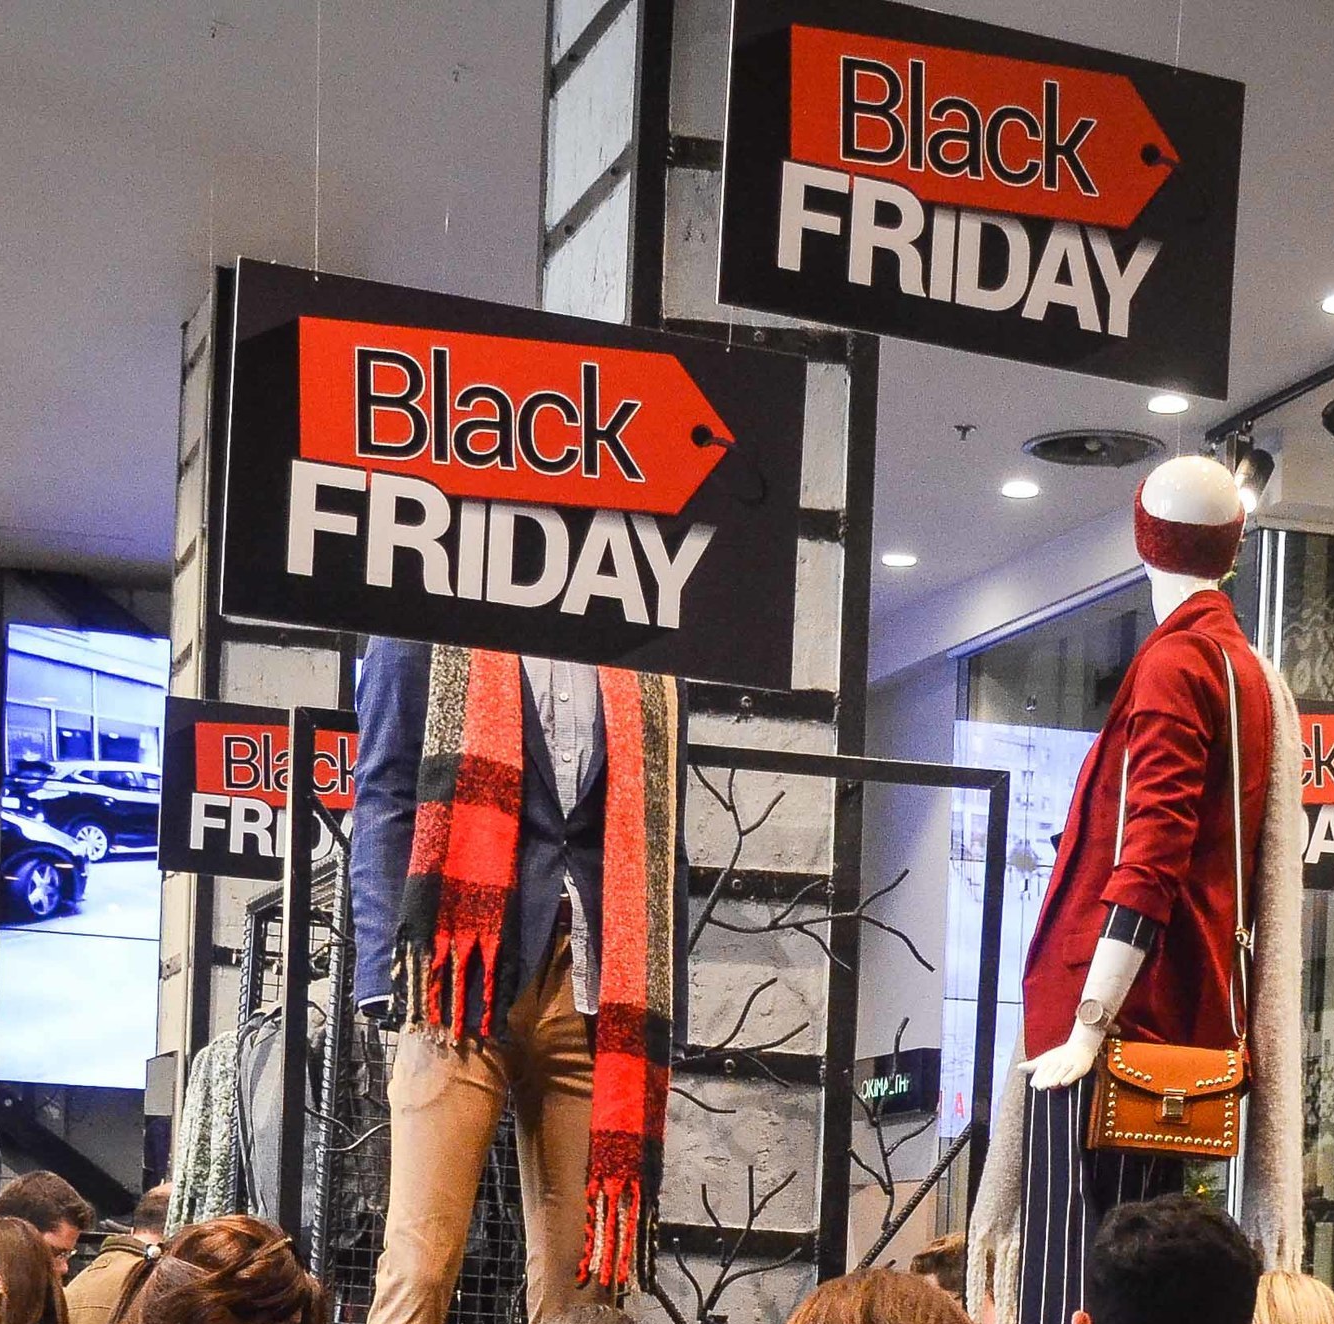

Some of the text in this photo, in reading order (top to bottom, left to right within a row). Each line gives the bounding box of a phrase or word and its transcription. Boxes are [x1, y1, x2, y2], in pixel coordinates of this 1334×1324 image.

[840, 55, 1100, 197] Black
[777, 161, 1163, 338] FRIDAY
[355, 346, 646, 483] Black
[287, 459, 717, 629] FRIDAY
